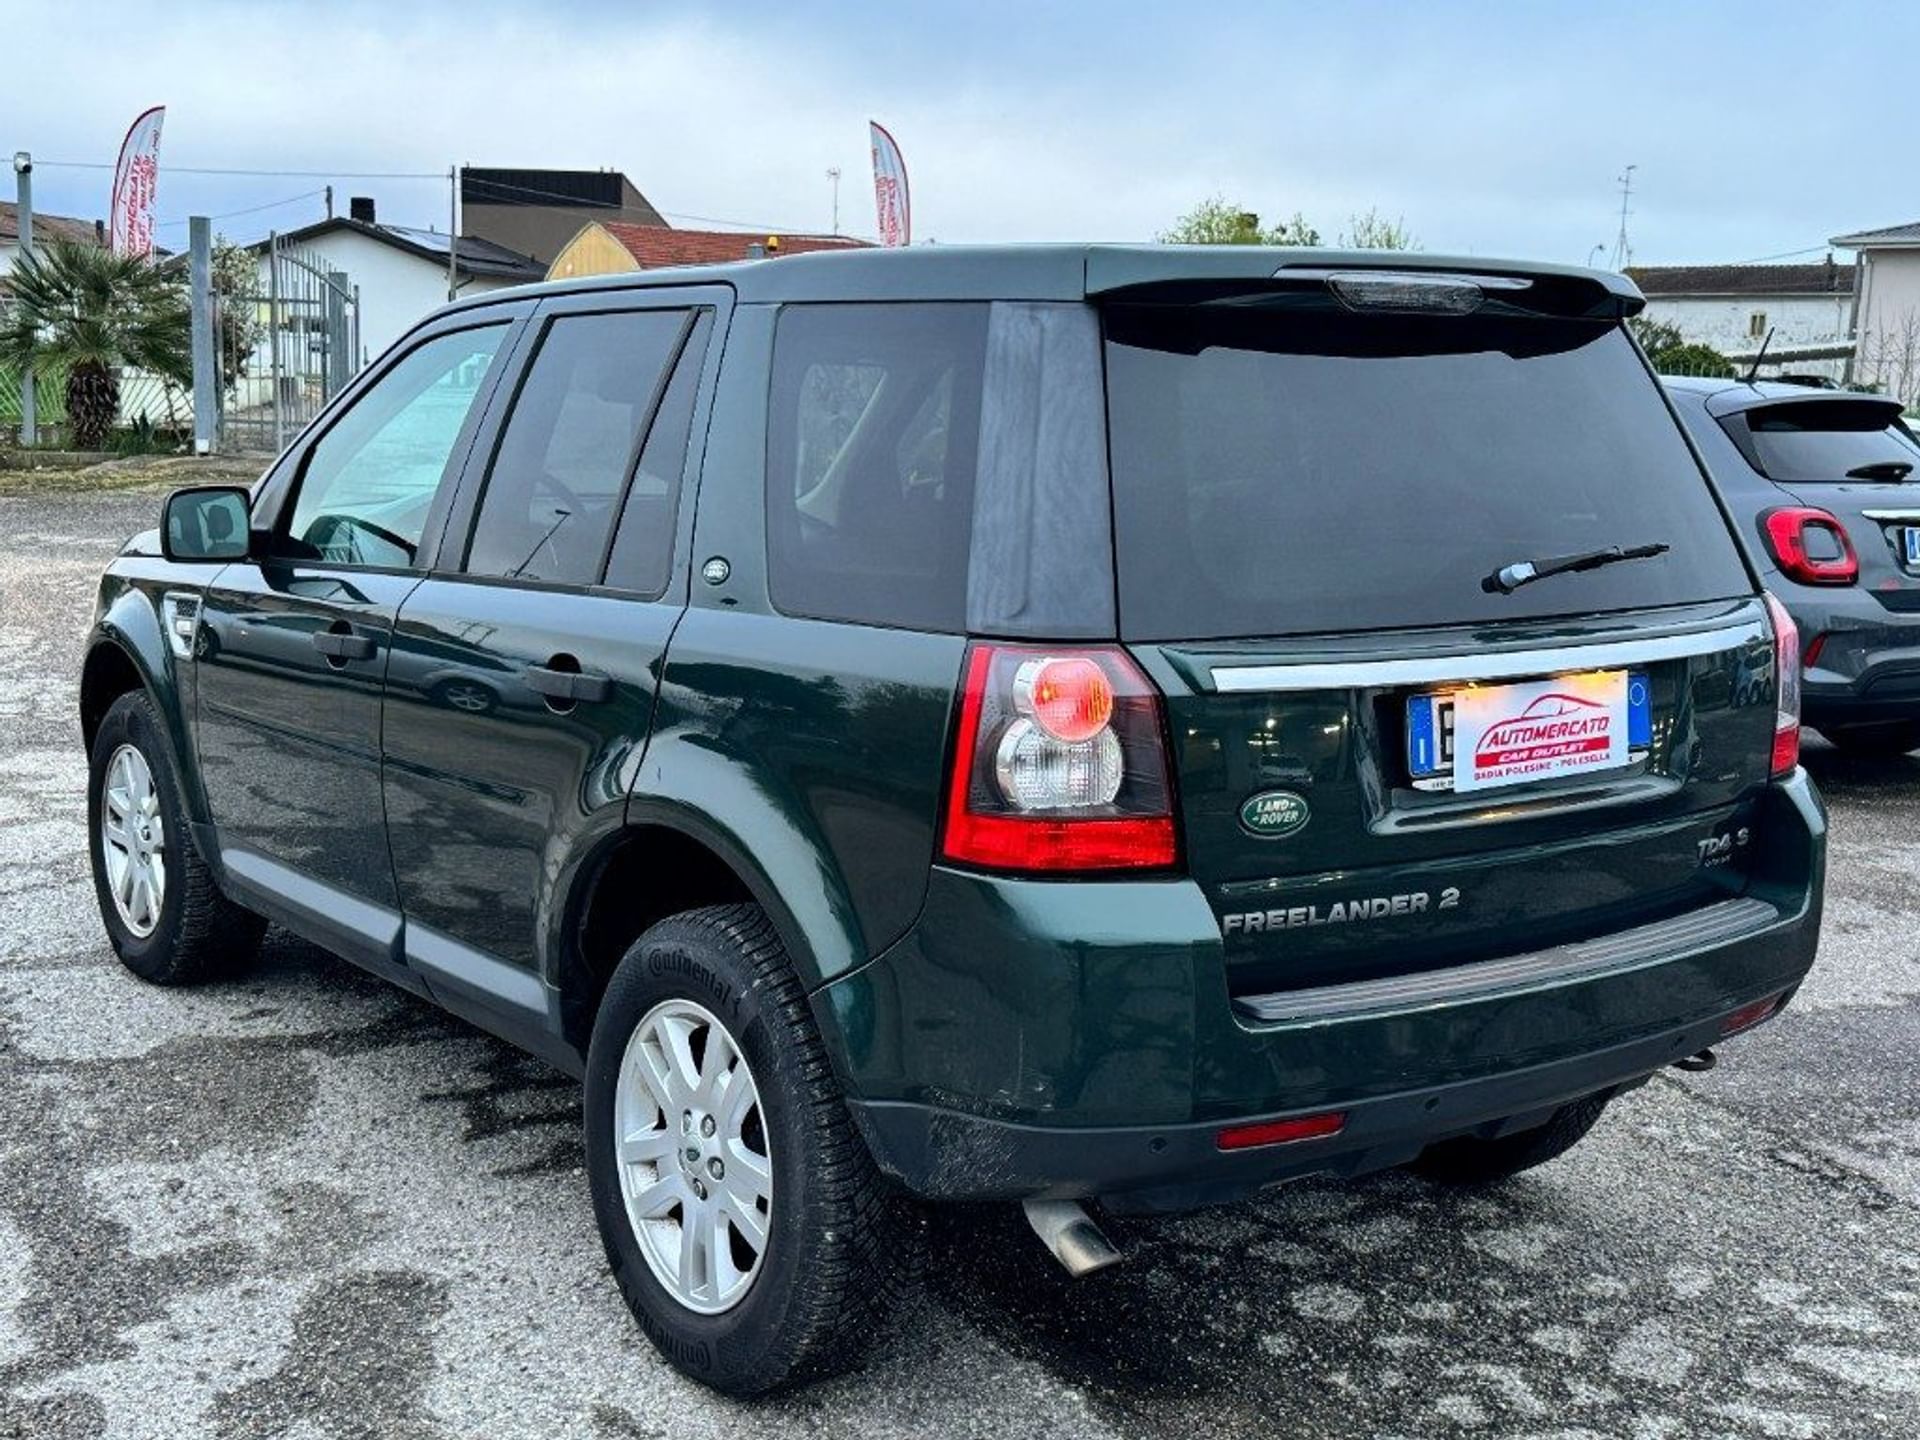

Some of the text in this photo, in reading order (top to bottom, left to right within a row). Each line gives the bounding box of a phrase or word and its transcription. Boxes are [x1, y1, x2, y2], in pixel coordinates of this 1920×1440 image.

[1486, 716, 1610, 749] AUTOMERCATO
[1474, 769, 1503, 781] BADIA
[1505, 762, 1552, 776] POLESINE
[1560, 753, 1611, 768] POLESELLA
[1498, 742, 1587, 763] CAR OUTLET
[1259, 810, 1299, 825] ROVER
[1222, 887, 1461, 936] FREELANDER 2
[648, 948, 732, 1006] Continental
